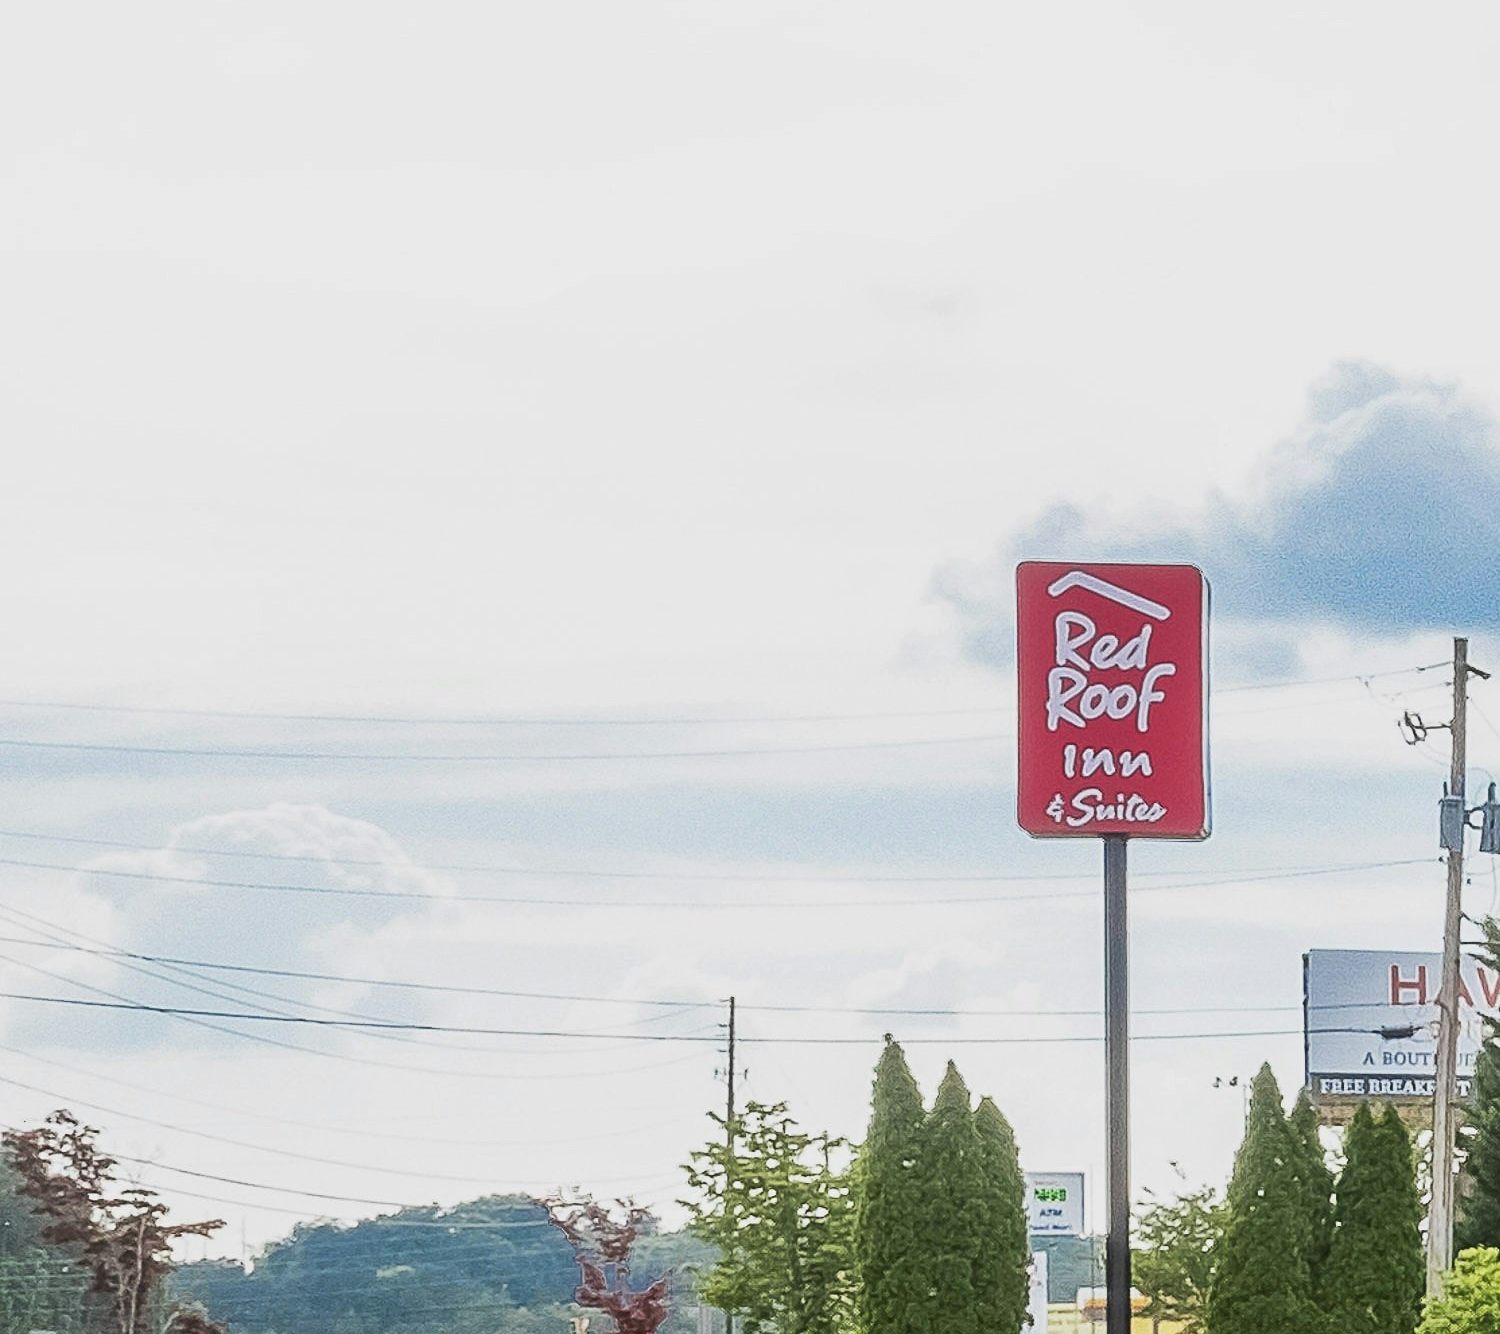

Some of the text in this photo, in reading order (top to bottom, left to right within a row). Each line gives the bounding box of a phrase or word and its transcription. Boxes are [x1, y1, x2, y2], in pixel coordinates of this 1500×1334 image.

[1054, 611, 1152, 671] Red
[1046, 663, 1176, 732] Roof
[1063, 744, 1153, 778] Inn
[1066, 788, 1167, 827] Suites
[1362, 1052, 1375, 1065] A
[1320, 1078, 1365, 1094] FREE
